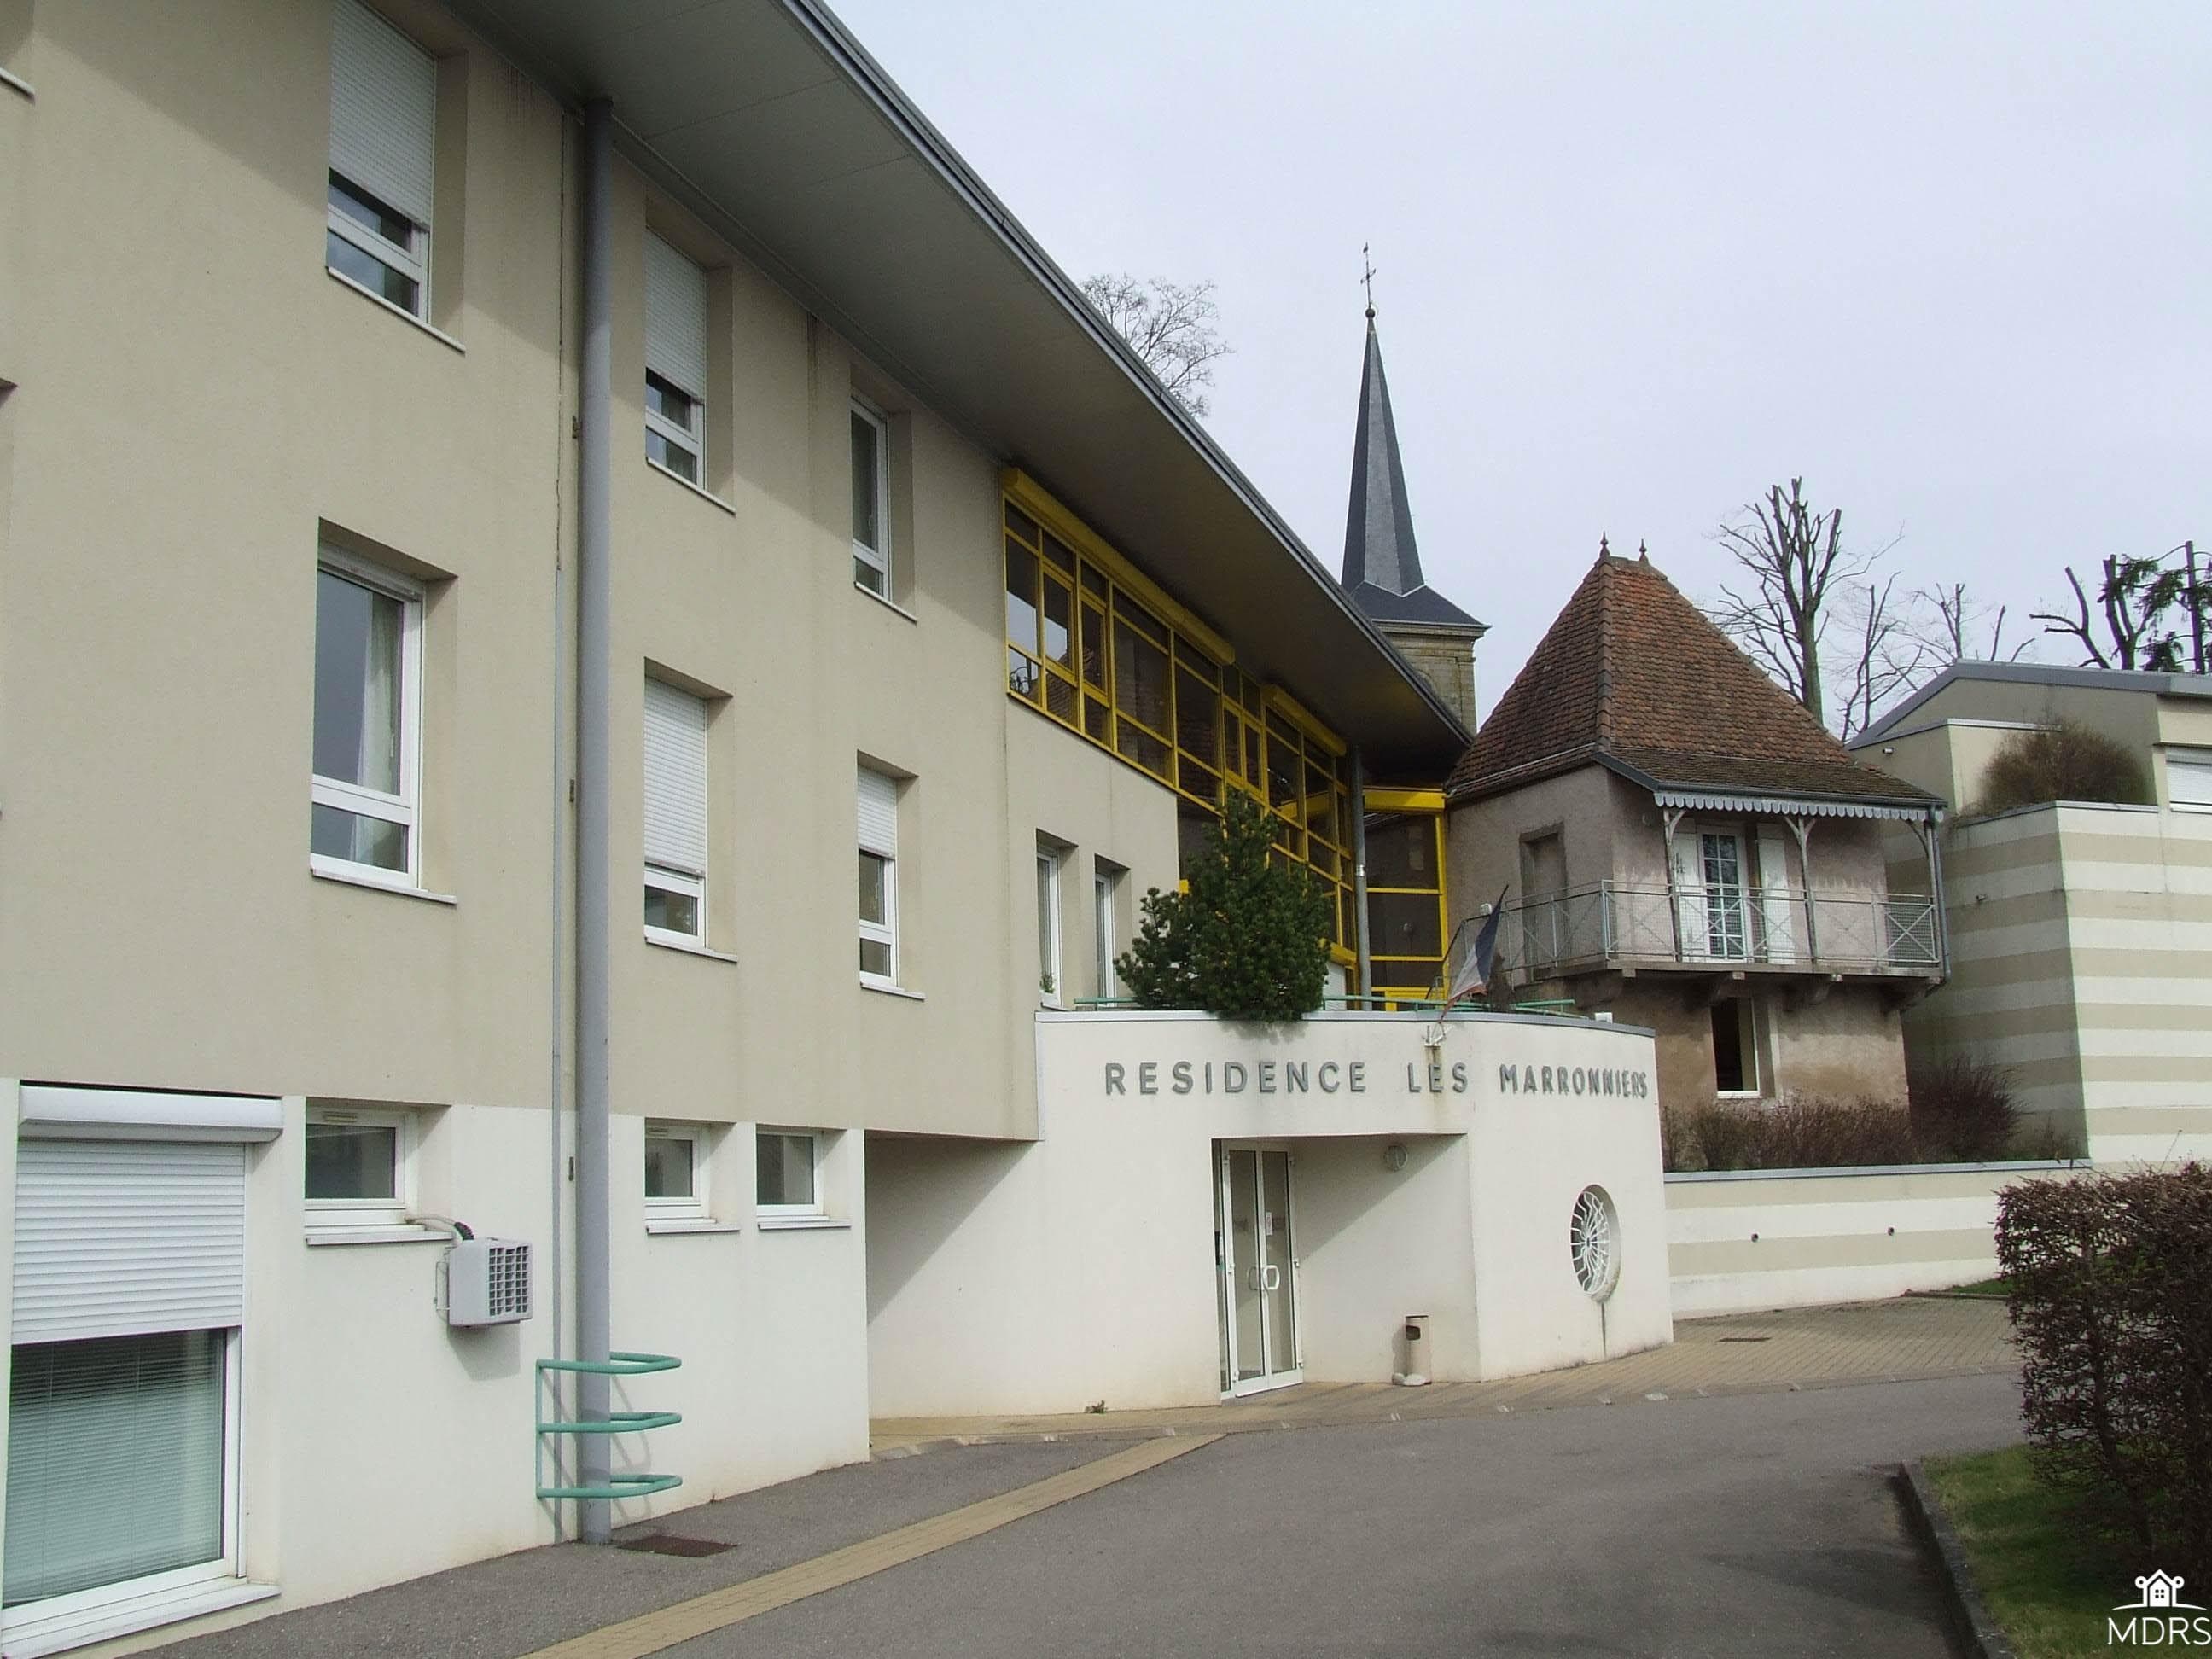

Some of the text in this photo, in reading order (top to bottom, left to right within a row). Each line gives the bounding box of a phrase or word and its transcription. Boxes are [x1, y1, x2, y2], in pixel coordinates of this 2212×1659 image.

[1105, 1061, 1648, 1099] RESIDENCE LES MARRONNIERS
